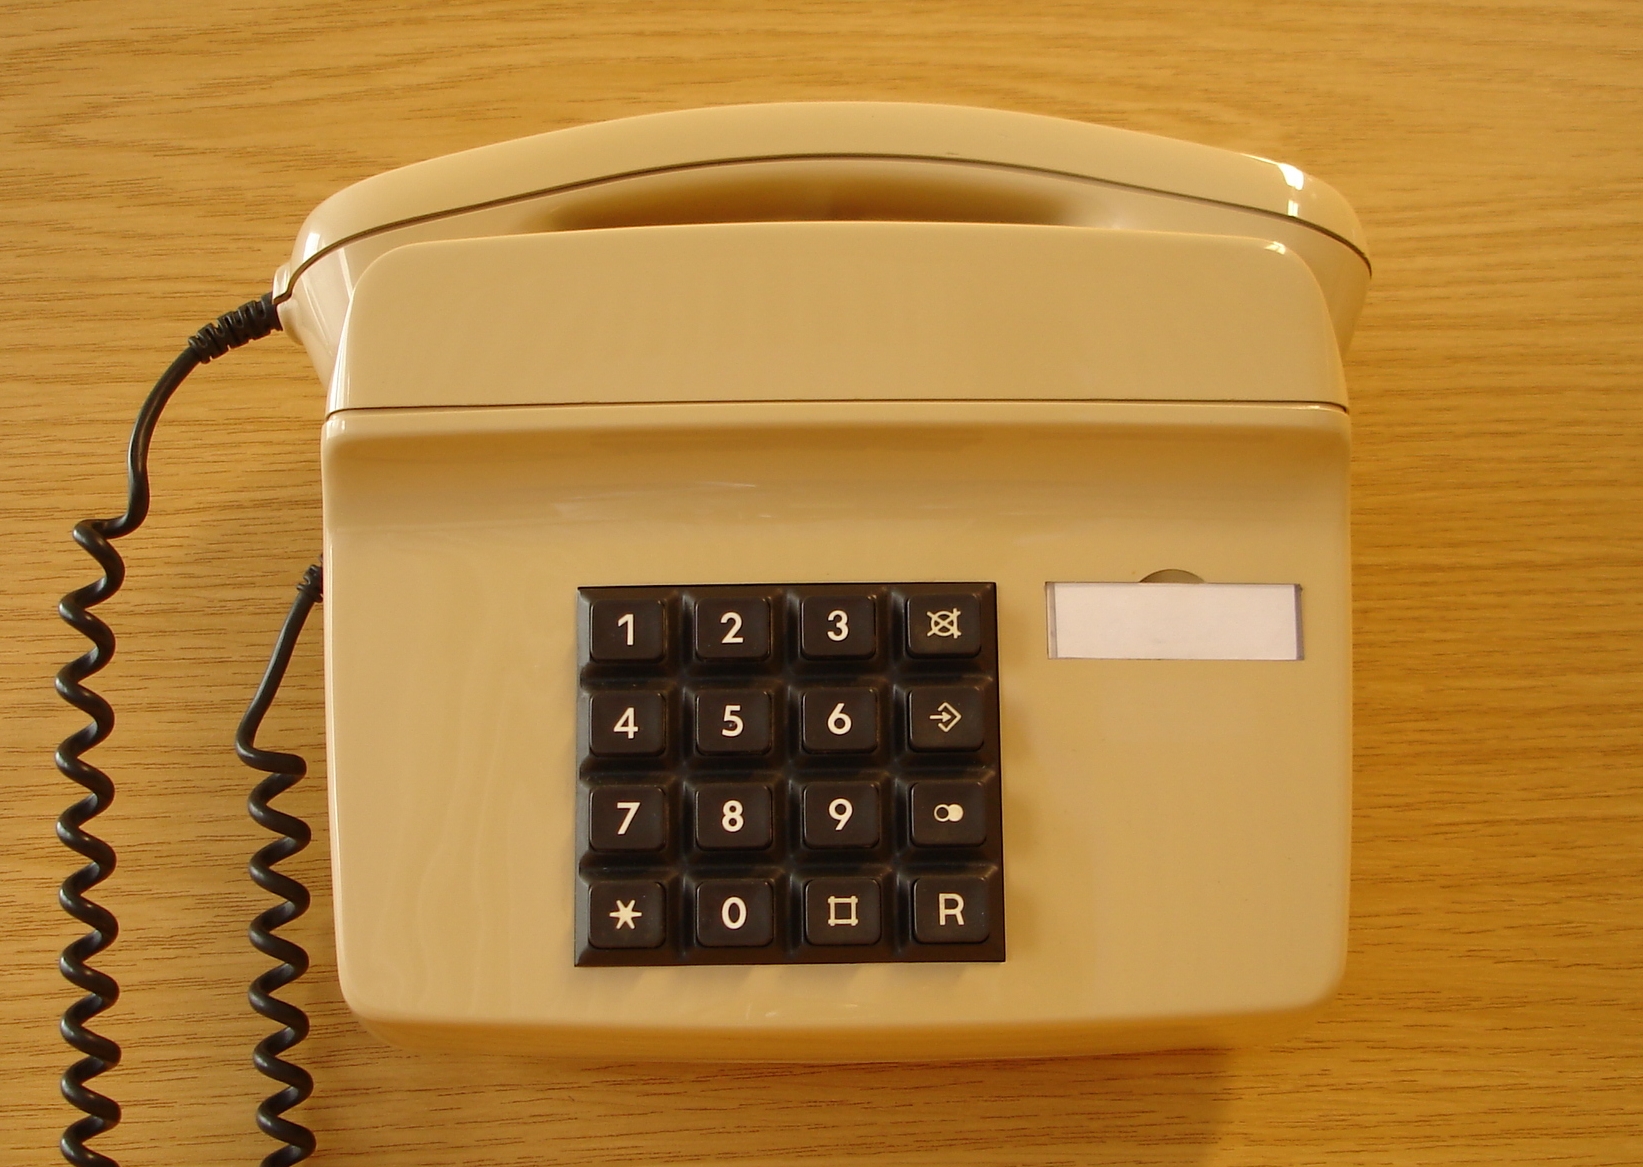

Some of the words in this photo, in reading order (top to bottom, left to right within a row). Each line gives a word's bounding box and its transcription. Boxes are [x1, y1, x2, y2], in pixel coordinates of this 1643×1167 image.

[617, 613, 634, 646] 1
[720, 612, 744, 644] 2
[827, 610, 849, 641] 3
[613, 707, 639, 739] 4
[721, 705, 744, 737] 5
[827, 703, 852, 735] 6
[617, 802, 641, 835] 7
[721, 800, 744, 832] 8
[828, 798, 853, 831] 9
[721, 896, 747, 930] 0
[939, 893, 965, 926] R
